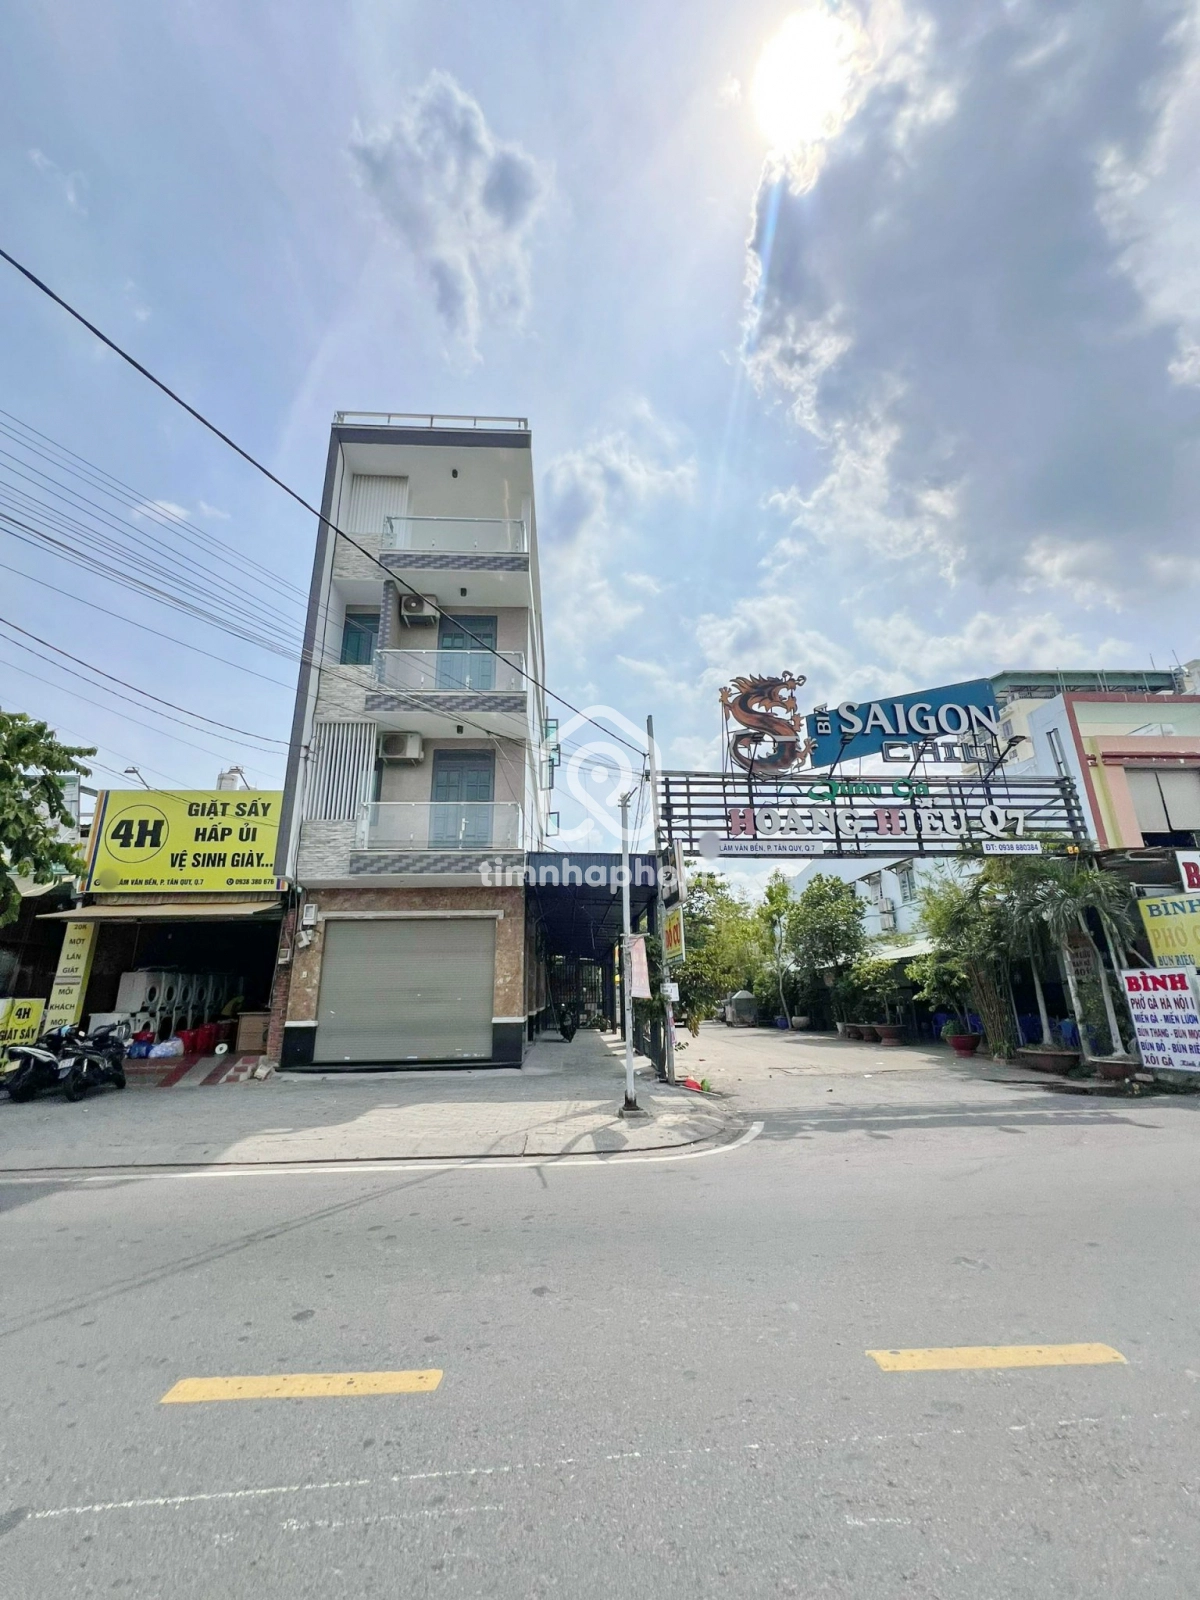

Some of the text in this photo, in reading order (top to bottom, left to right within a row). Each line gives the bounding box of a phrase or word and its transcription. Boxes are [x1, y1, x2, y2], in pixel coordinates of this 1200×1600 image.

[815, 702, 831, 734] BIA
[838, 702, 999, 736] SAIGON
[882, 741, 1008, 763] CHILL
[187, 797, 272, 820] GIẶT SẤY
[728, 797, 863, 836] HOÀNG
[980, 804, 1025, 838] Q7
[111, 819, 165, 848] 4H
[194, 822, 258, 842] HẤP ỦI
[985, 843, 998, 851] ĐT:
[998, 843, 1015, 851] 0938
[170, 849, 189, 872] VỆ
[191, 852, 228, 868] SINH
[1157, 952, 1174, 966] BÚN
[1125, 971, 1189, 992] BÌNH
[15, 1007, 31, 1019] 4H
[49, 1003, 75, 1011] KHÁCH
[1130, 994, 1146, 1010] PHỞ
[1148, 995, 1159, 1010] GÀ
[1160, 994, 1172, 1010] HÀ
[1172, 994, 1189, 1012] NỘI
[1150, 1012, 1159, 1023] GÀ
[1140, 1039, 1155, 1052] BÚN
[1172, 1041, 1187, 1054] BÚN
[1144, 1053, 1175, 1067] XÔI GÀ
